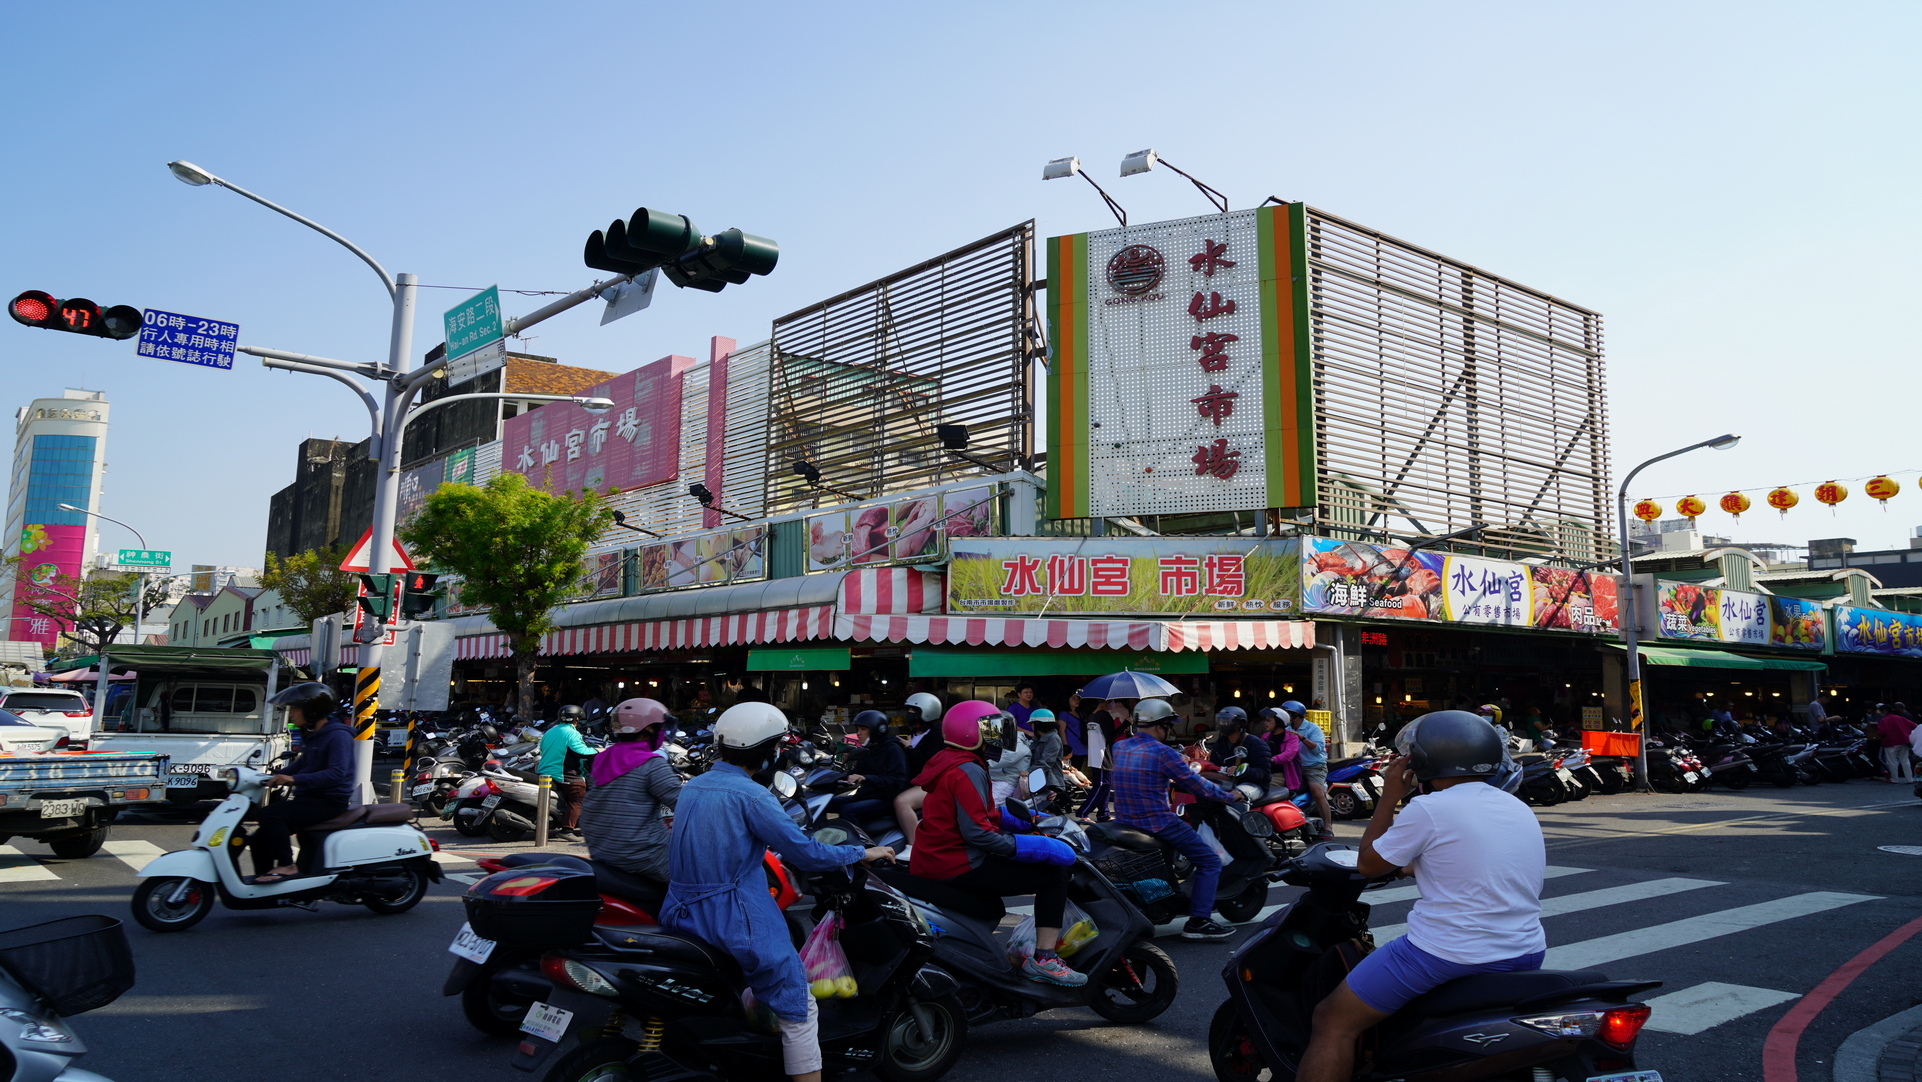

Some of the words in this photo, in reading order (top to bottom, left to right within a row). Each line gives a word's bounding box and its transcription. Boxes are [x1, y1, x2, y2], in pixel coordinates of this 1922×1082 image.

[1105, 296, 1137, 305] GONG
[1141, 292, 1164, 302] KOU
[62, 307, 90, 328] 47
[144, 311, 237, 339] 06時-23時
[448, 296, 495, 335] 海安路二段
[142, 327, 235, 353] 行人專用時相
[479, 327, 492, 338] Sec.
[140, 342, 231, 368] 請依號誌行駛
[1187, 239, 1241, 480] 水仙宮市場
[516, 407, 642, 474] 水仙宮市場
[1770, 491, 1793, 507] 建
[1815, 485, 1838, 502] 朝
[1867, 480, 1890, 496] 三
[1681, 499, 1700, 514] 大
[125, 550, 164, 559] 神農街
[1001, 554, 1130, 597] 水仙宮
[1158, 554, 1246, 597] 市場
[1451, 564, 1525, 603] 水仙宮
[1329, 582, 1368, 608] 海鮮
[1368, 597, 1402, 610] Seafood
[1462, 603, 1521, 621] 公有零售市場
[1571, 604, 1596, 626] 肉品
[1721, 596, 1767, 626] 水仙宮
[1785, 603, 1801, 619] 水果
[1666, 613, 1689, 632] 蔬菜
[1689, 623, 1717, 635] Vegetables
[1728, 628, 1765, 640] 公有零售市場
